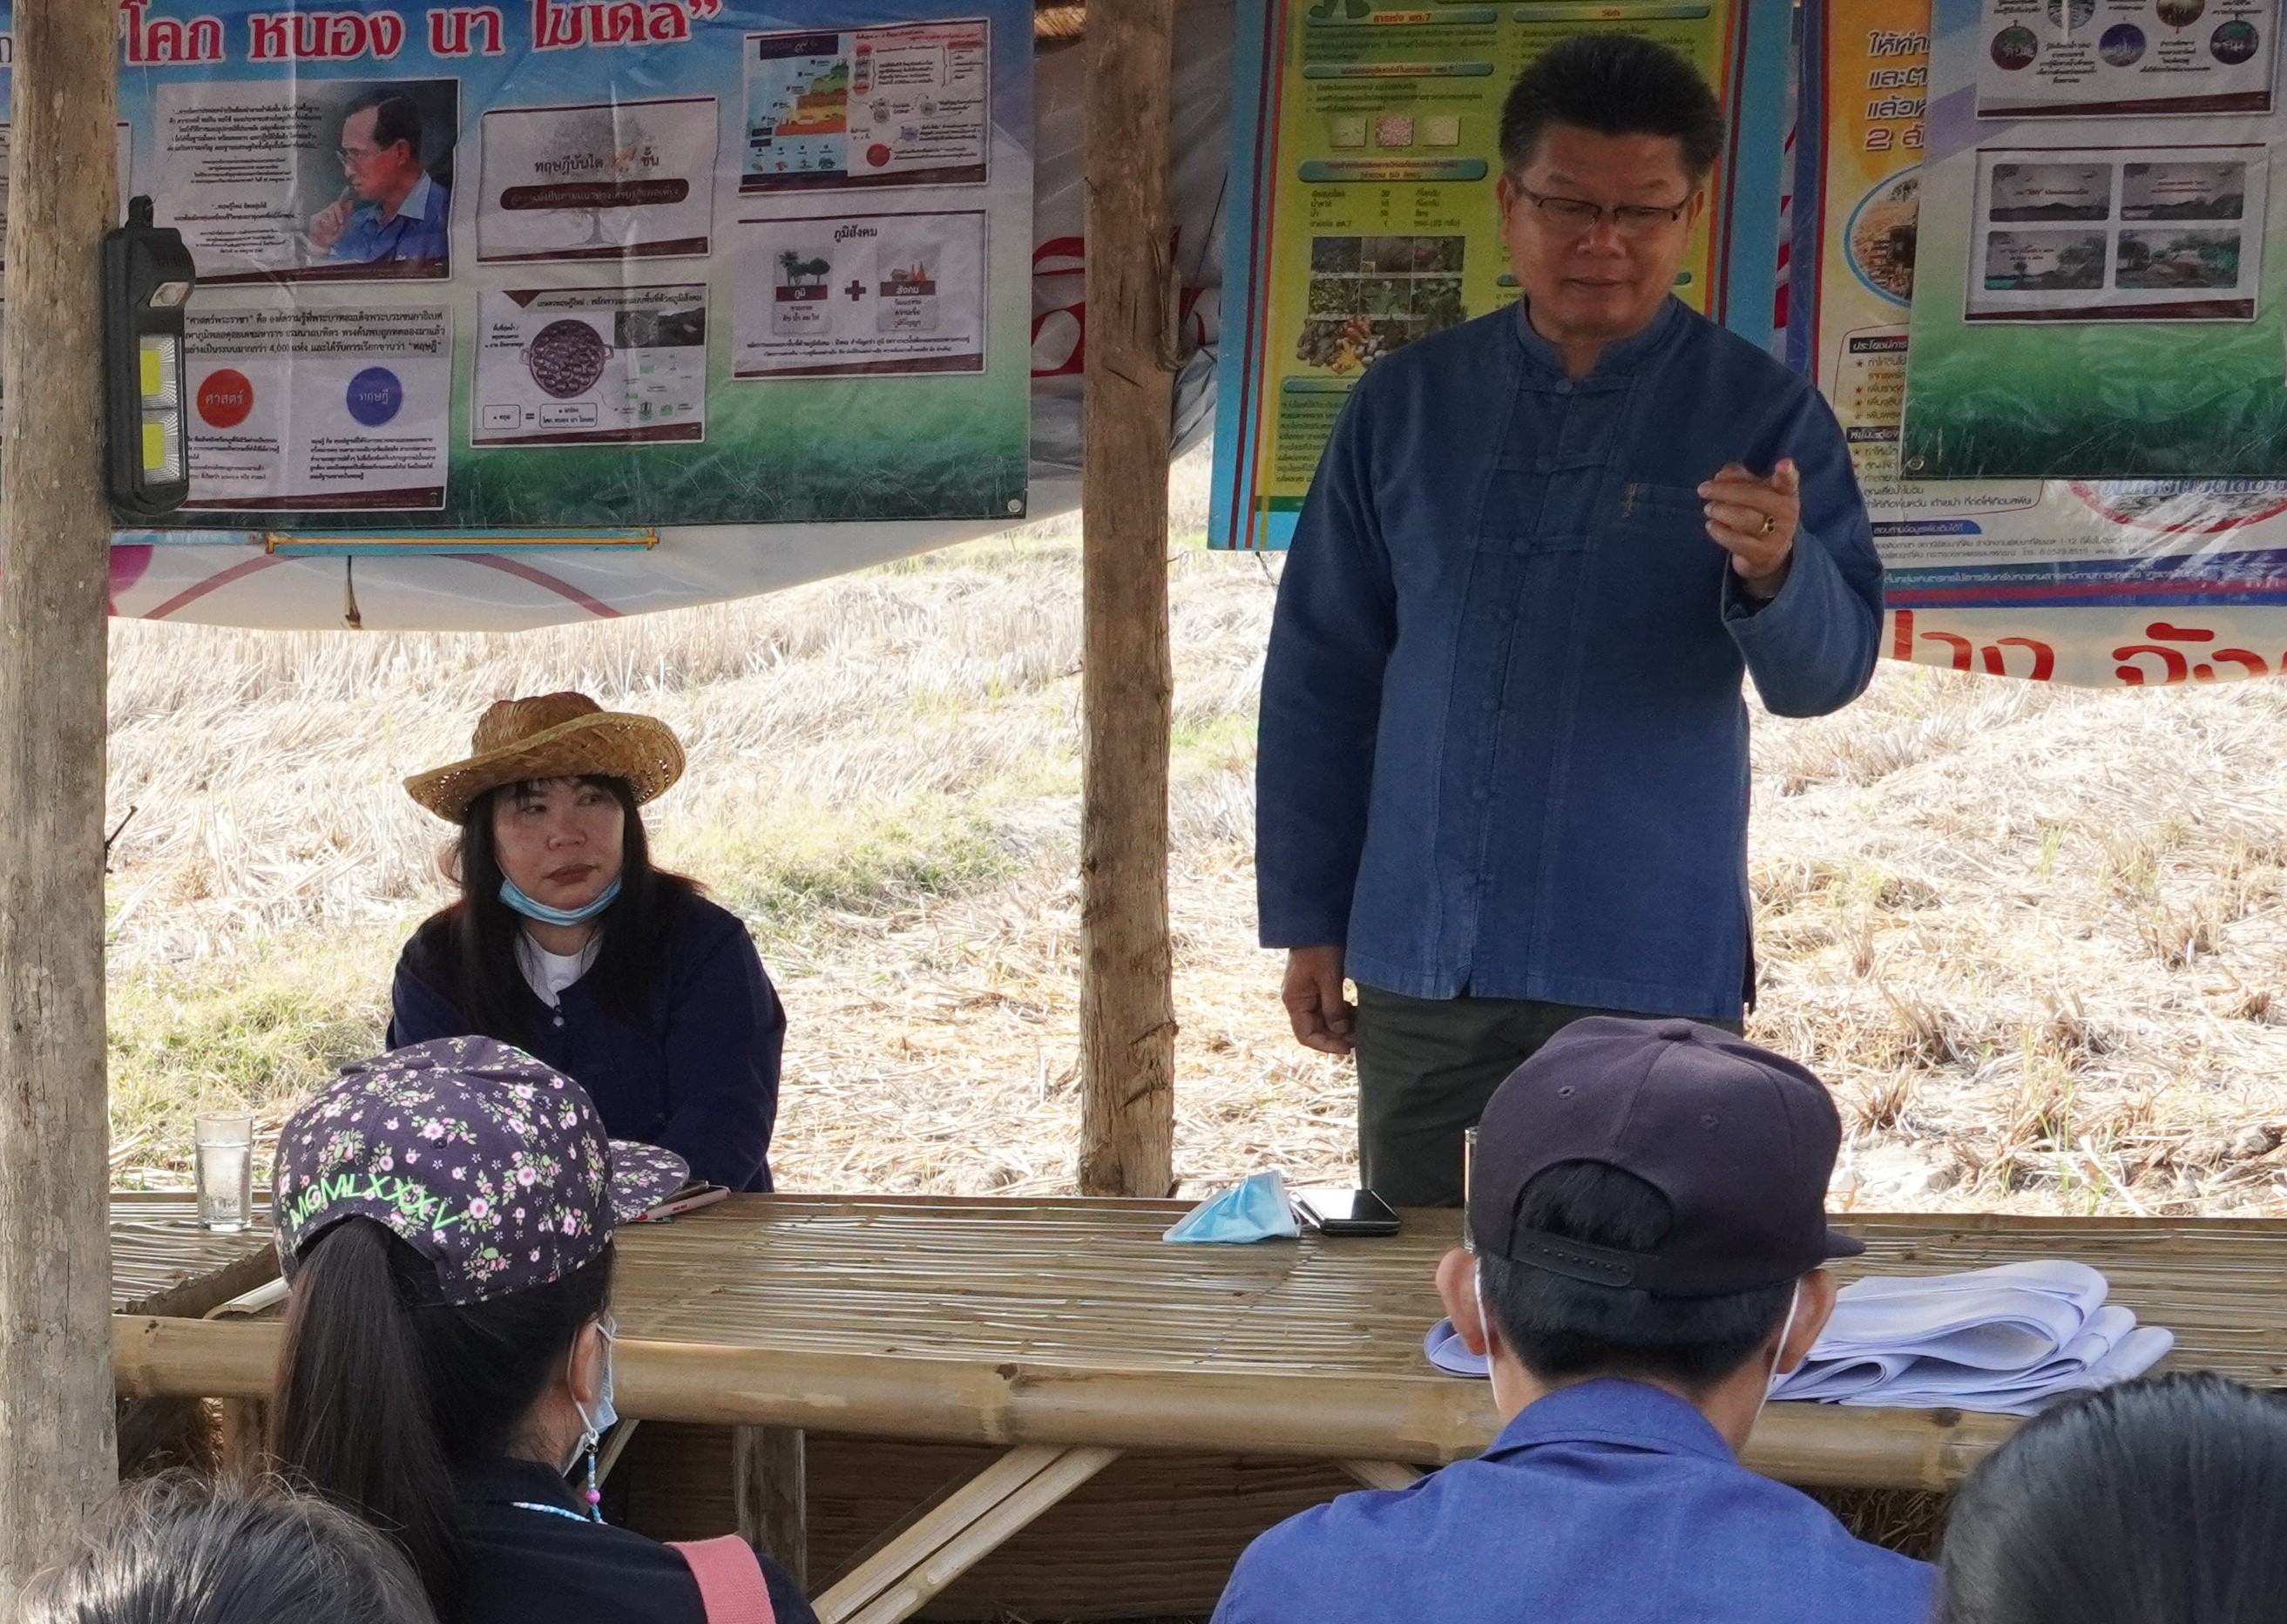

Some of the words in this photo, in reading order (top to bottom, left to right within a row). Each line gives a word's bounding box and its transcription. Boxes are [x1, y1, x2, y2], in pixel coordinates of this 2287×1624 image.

[251, 12, 403, 59] หนอง
[433, 10, 503, 53] นา
[1869, 32, 1930, 55] ให้ทำ
[1866, 128, 1891, 148] 2
[535, 153, 604, 175] ทฤษฎีบันได
[641, 147, 660, 167] ขั้น
[834, 226, 877, 242] ภูมิสังคม
[897, 284, 920, 294] สังคม
[206, 389, 245, 406] ศาสตร์
